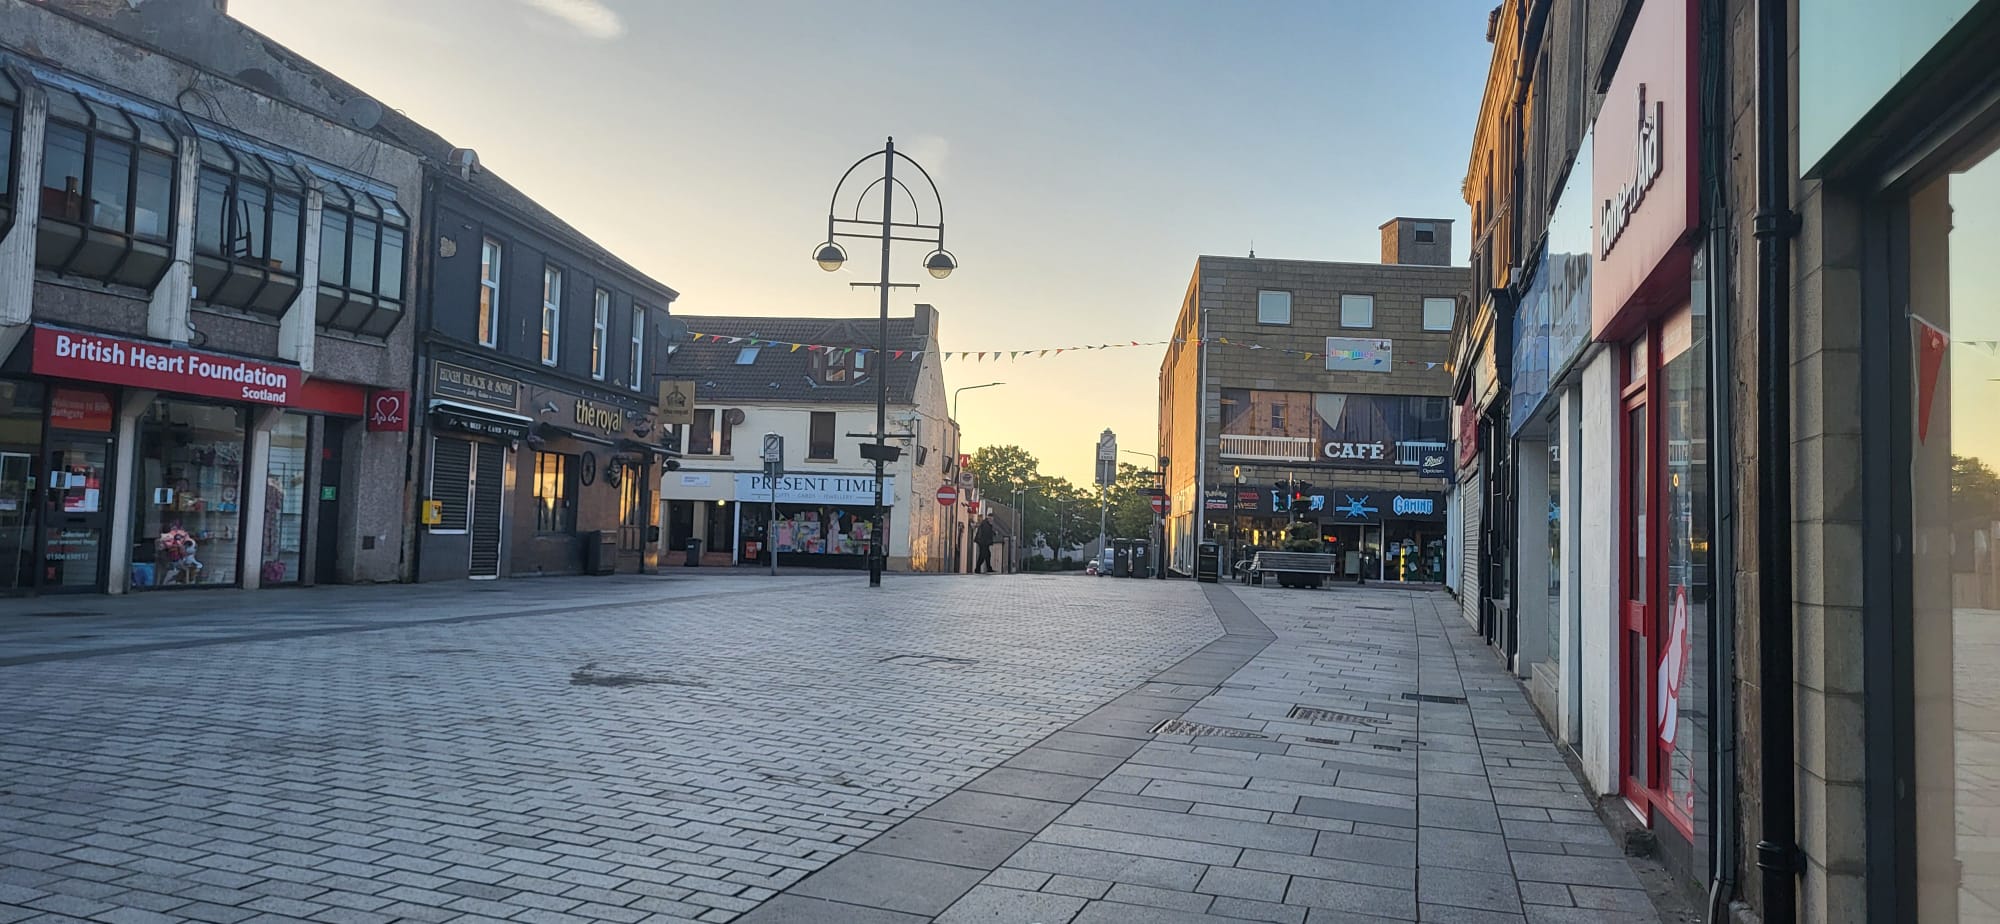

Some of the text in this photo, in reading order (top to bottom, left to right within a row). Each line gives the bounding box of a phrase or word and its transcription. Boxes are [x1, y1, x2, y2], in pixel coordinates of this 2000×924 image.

[1600, 183, 1628, 261] Home
[56, 335, 287, 388] British Heart Foundation
[242, 386, 286, 403] Scotland
[463, 373, 486, 390] BLACK
[487, 380, 493, 391] &
[495, 381, 513, 396] SONS
[576, 399, 623, 435] the royal
[1324, 440, 1385, 460] CAFÉ
[751, 475, 828, 491] PRESENT
